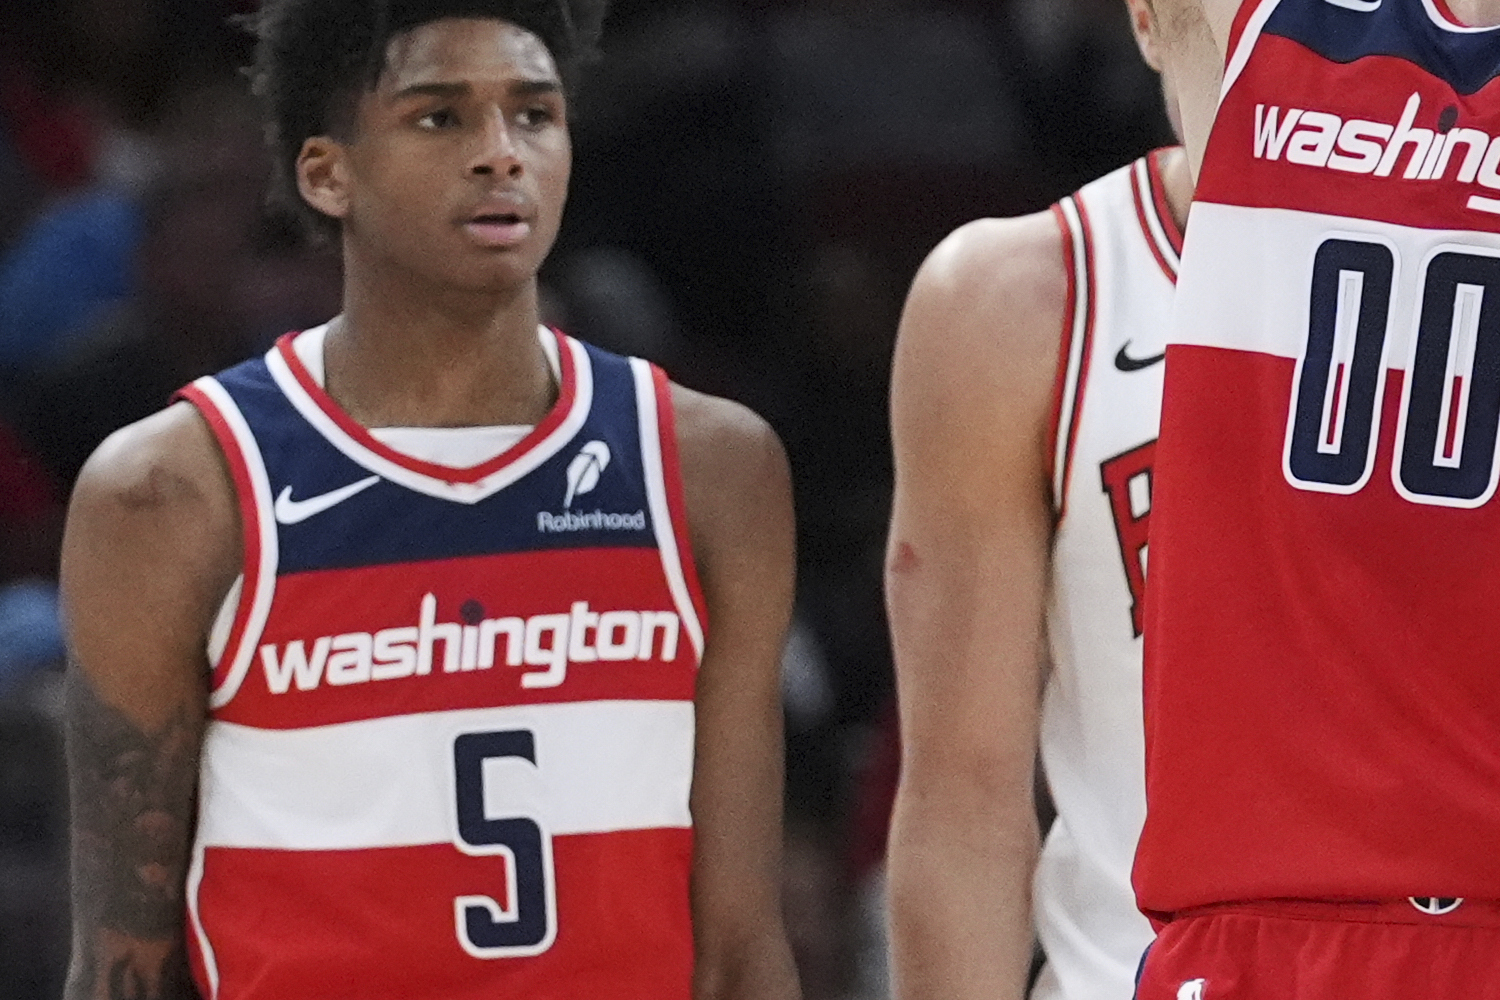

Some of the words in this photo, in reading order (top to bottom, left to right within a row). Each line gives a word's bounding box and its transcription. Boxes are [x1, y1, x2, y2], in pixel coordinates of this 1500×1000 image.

[536, 508, 646, 533] Robinhood
[259, 592, 680, 694] washington
[451, 727, 552, 955] 5
